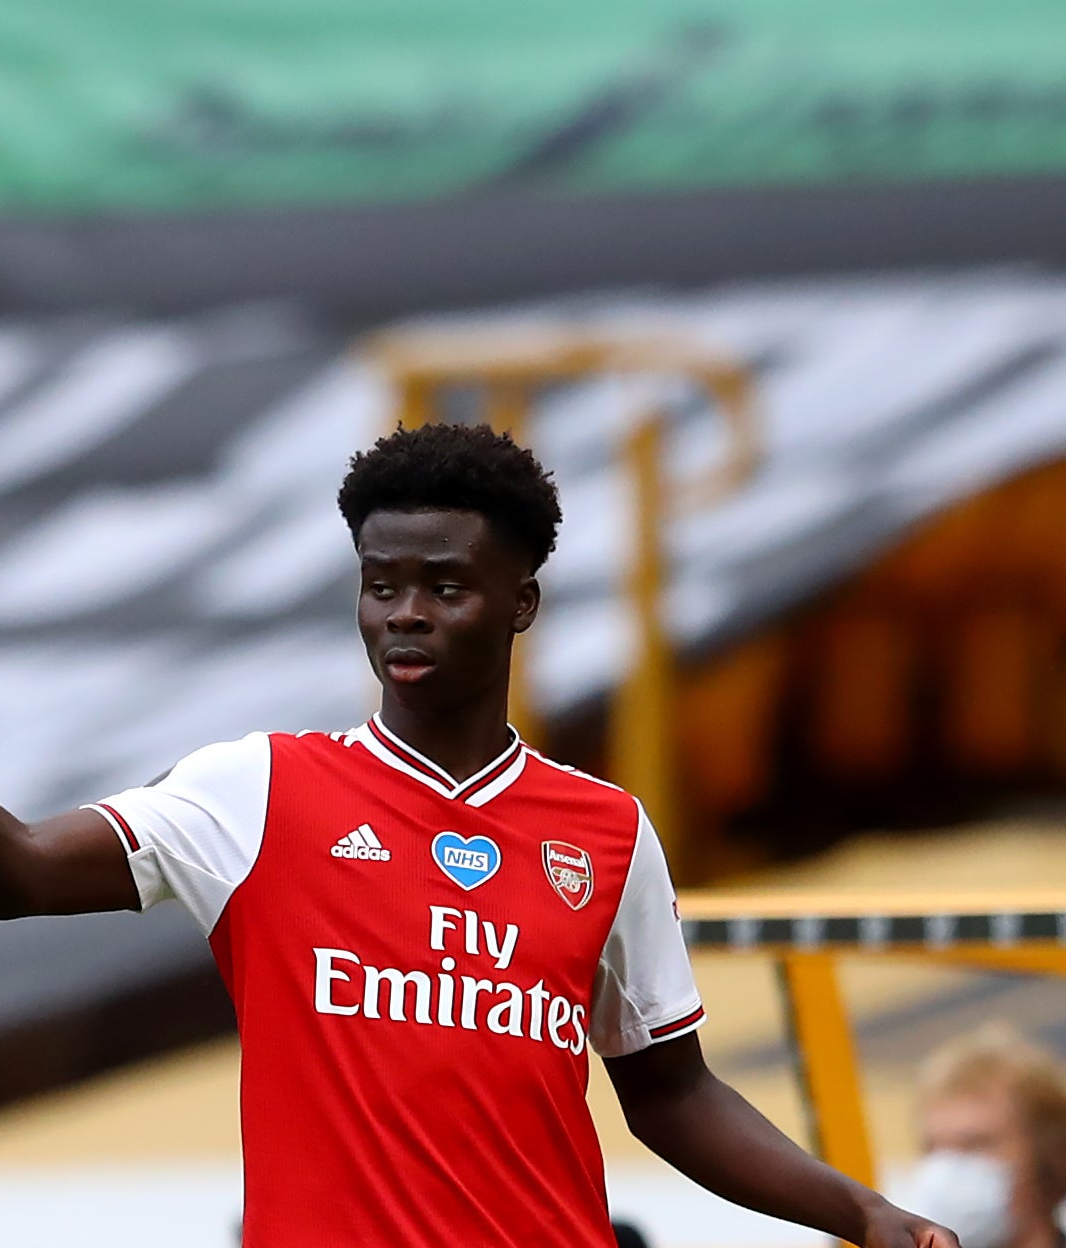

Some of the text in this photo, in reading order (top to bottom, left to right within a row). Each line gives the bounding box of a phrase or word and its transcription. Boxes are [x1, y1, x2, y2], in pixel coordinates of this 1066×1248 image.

[330, 844, 392, 862] adidas
[446, 850, 485, 868] NHS
[549, 850, 586, 868] Arsenal
[429, 905, 519, 970] Fly
[312, 947, 586, 1056] Emirates
